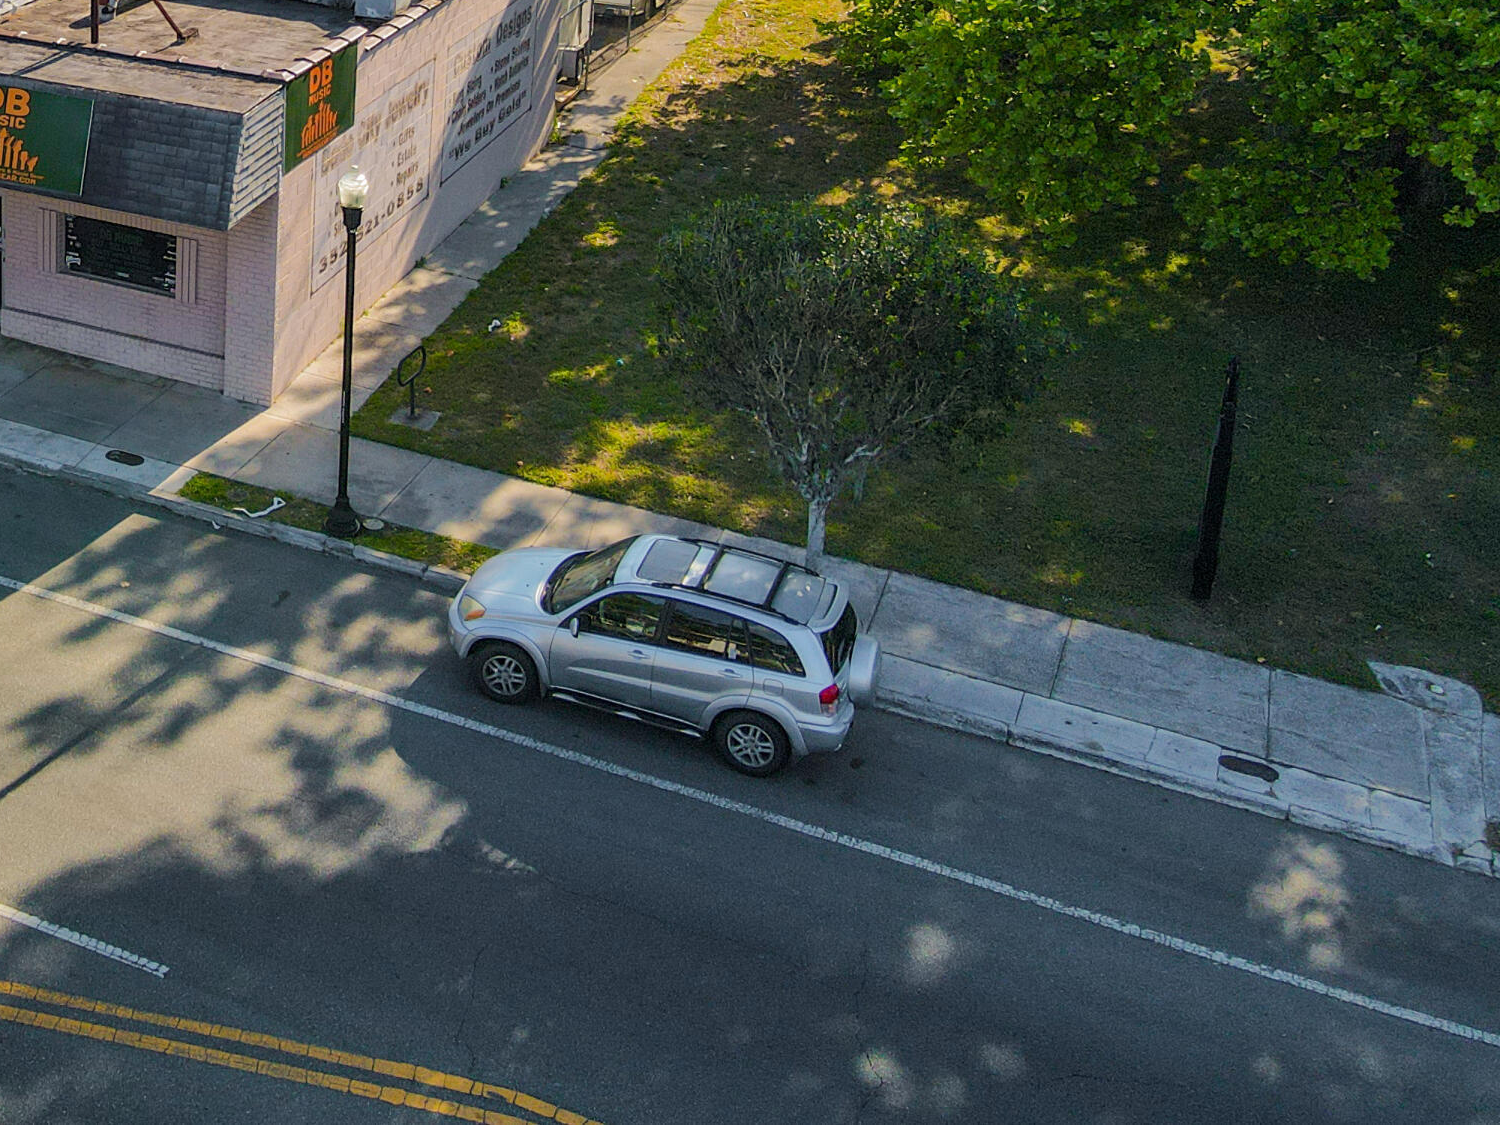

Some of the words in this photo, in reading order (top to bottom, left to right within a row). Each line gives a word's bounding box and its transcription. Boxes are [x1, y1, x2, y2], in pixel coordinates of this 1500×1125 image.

[496, 4, 533, 46] Designs
[309, 58, 333, 94] DB
[308, 83, 332, 107] MUSIC
[398, 128, 415, 146] Gifts
[475, 118, 496, 143] Buy
